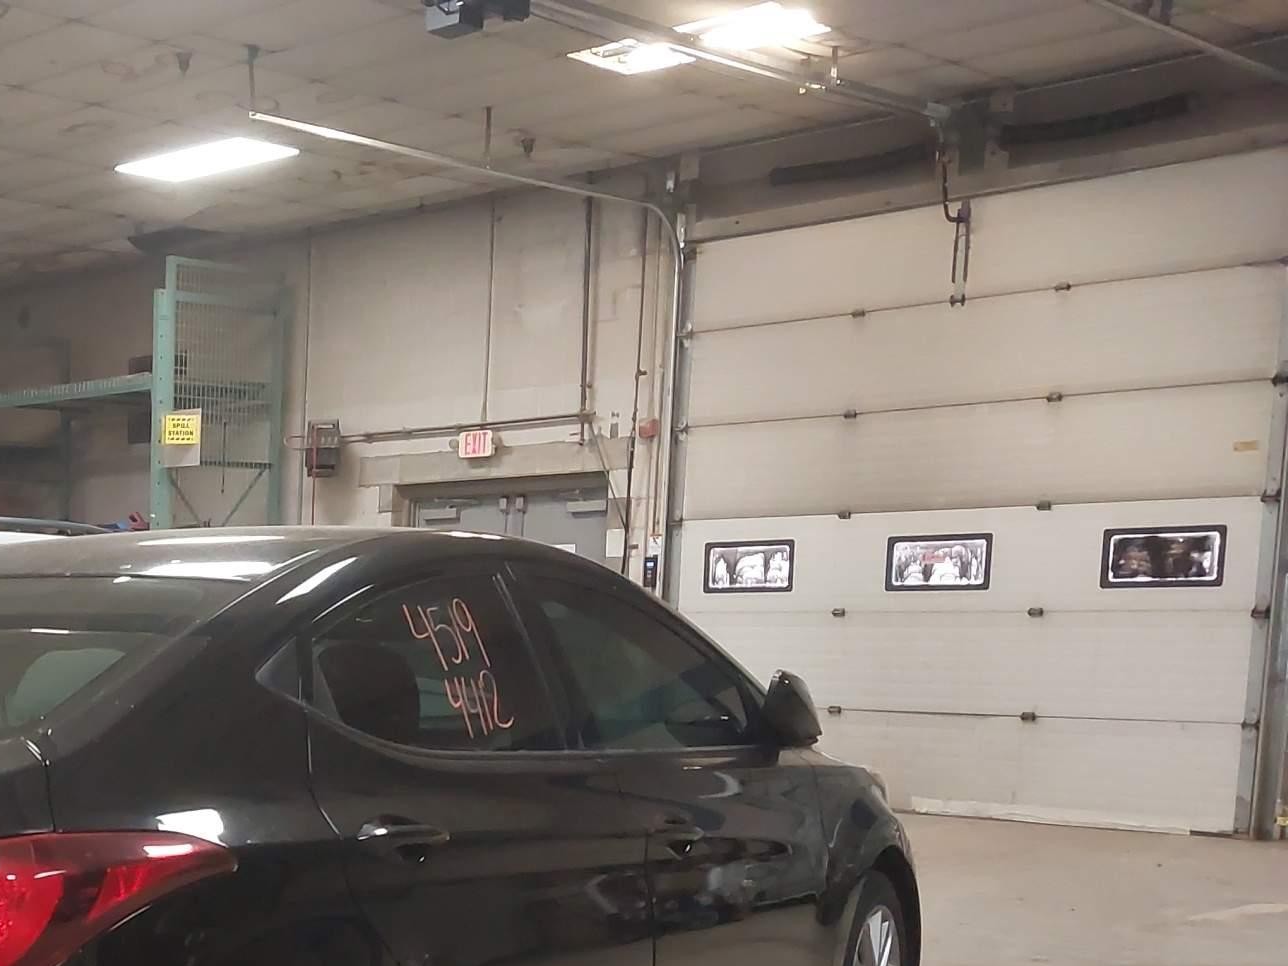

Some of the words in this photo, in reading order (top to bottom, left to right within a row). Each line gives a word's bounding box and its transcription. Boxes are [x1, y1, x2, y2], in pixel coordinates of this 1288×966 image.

[464, 431, 489, 456] EXIT
[402, 598, 490, 671] 4519
[445, 669, 514, 739] 4412
